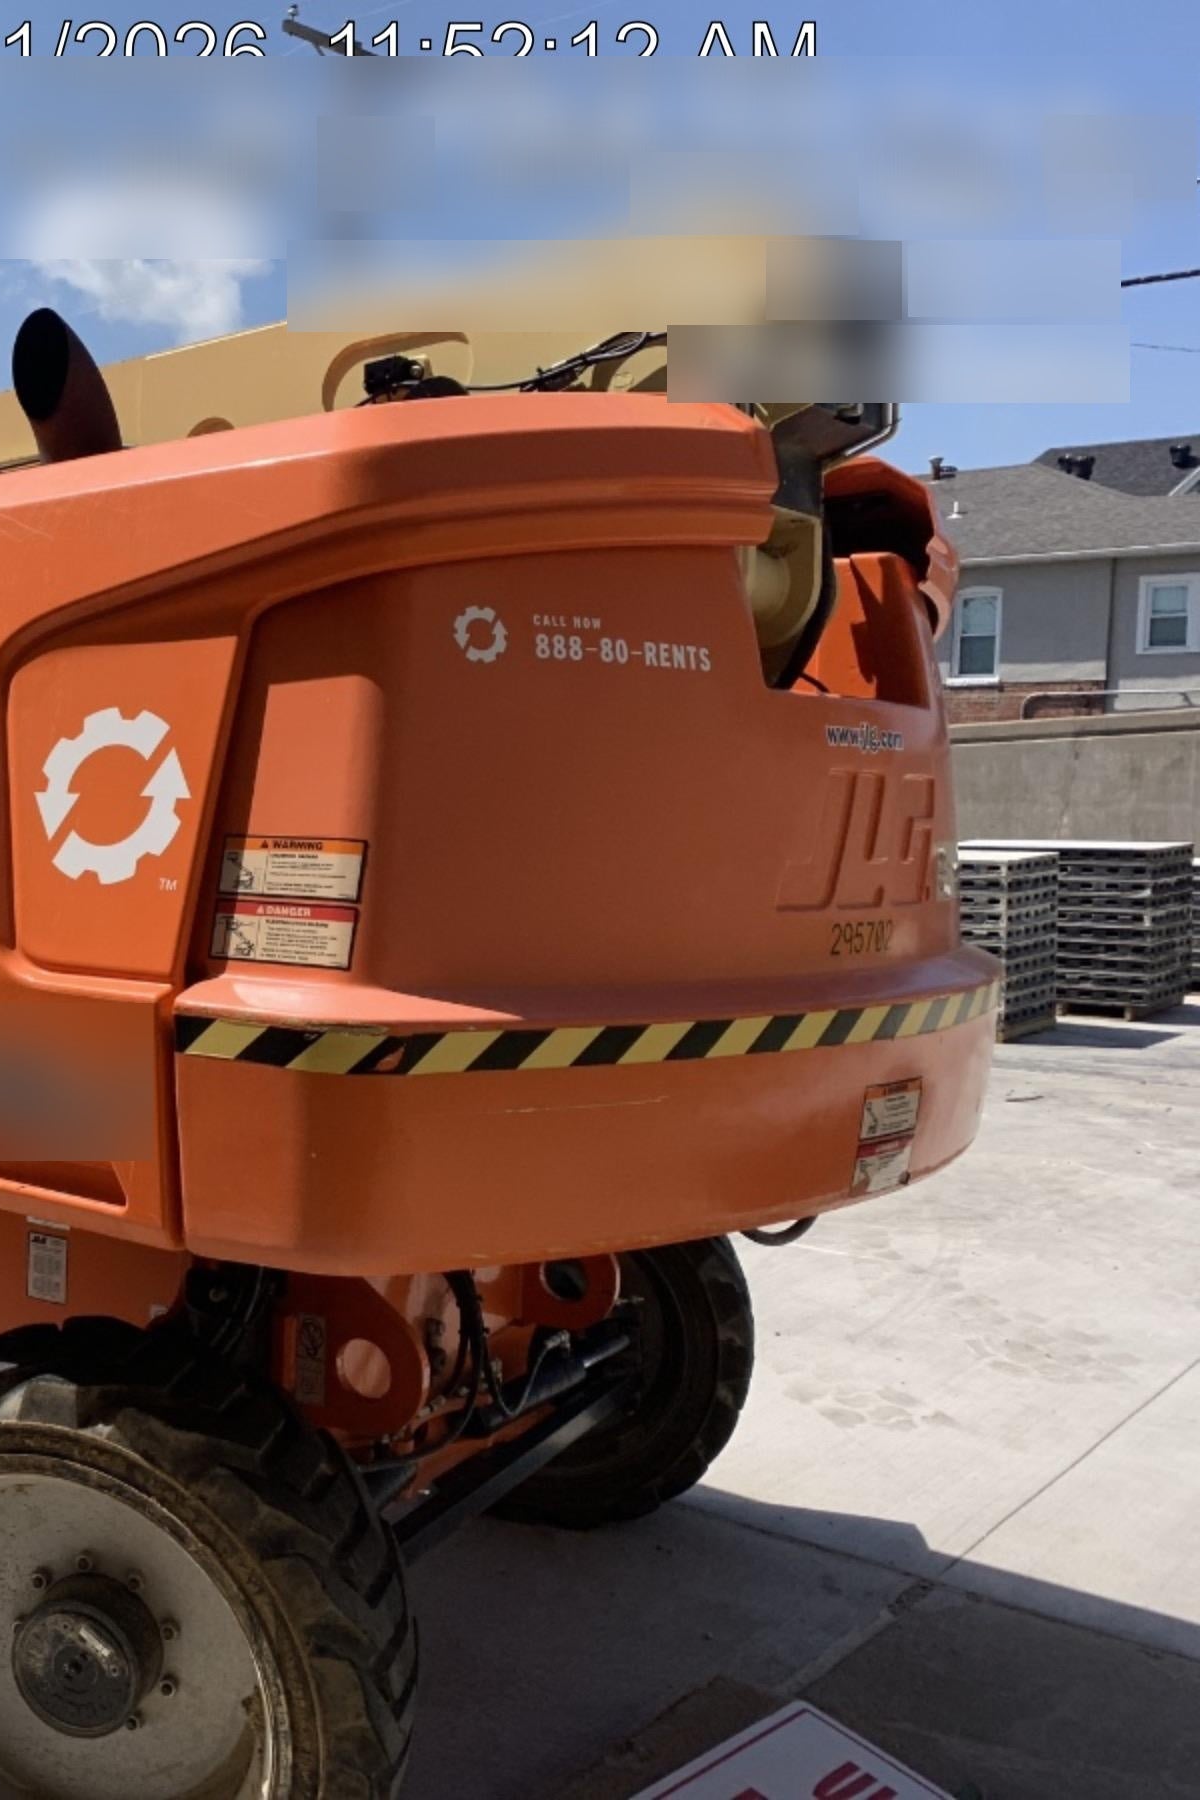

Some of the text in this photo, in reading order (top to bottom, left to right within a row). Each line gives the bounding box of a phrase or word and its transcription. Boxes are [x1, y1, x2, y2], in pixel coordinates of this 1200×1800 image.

[533, 614, 601, 630] CALL NOW
[535, 633, 711, 672] 888-80-RENTS
[272, 840, 324, 851] WARNING
[159, 878, 177, 891] TM
[266, 905, 311, 917] DANGER
